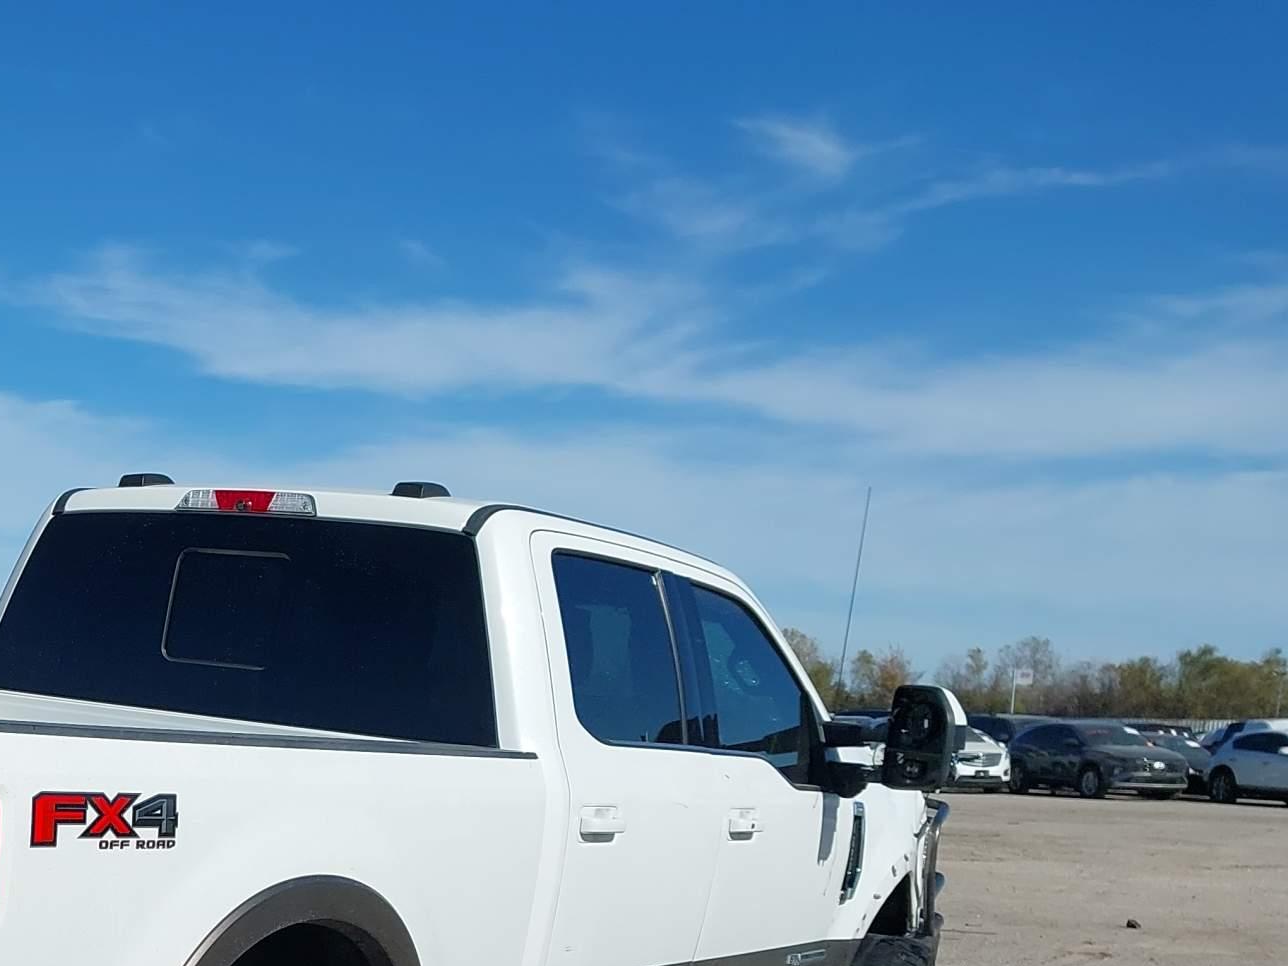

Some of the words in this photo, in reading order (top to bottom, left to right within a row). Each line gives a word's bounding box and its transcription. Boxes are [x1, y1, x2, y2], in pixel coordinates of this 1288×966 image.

[30, 791, 178, 848] FX4
[98, 839, 130, 850] OFF
[135, 839, 176, 850] ROAD
